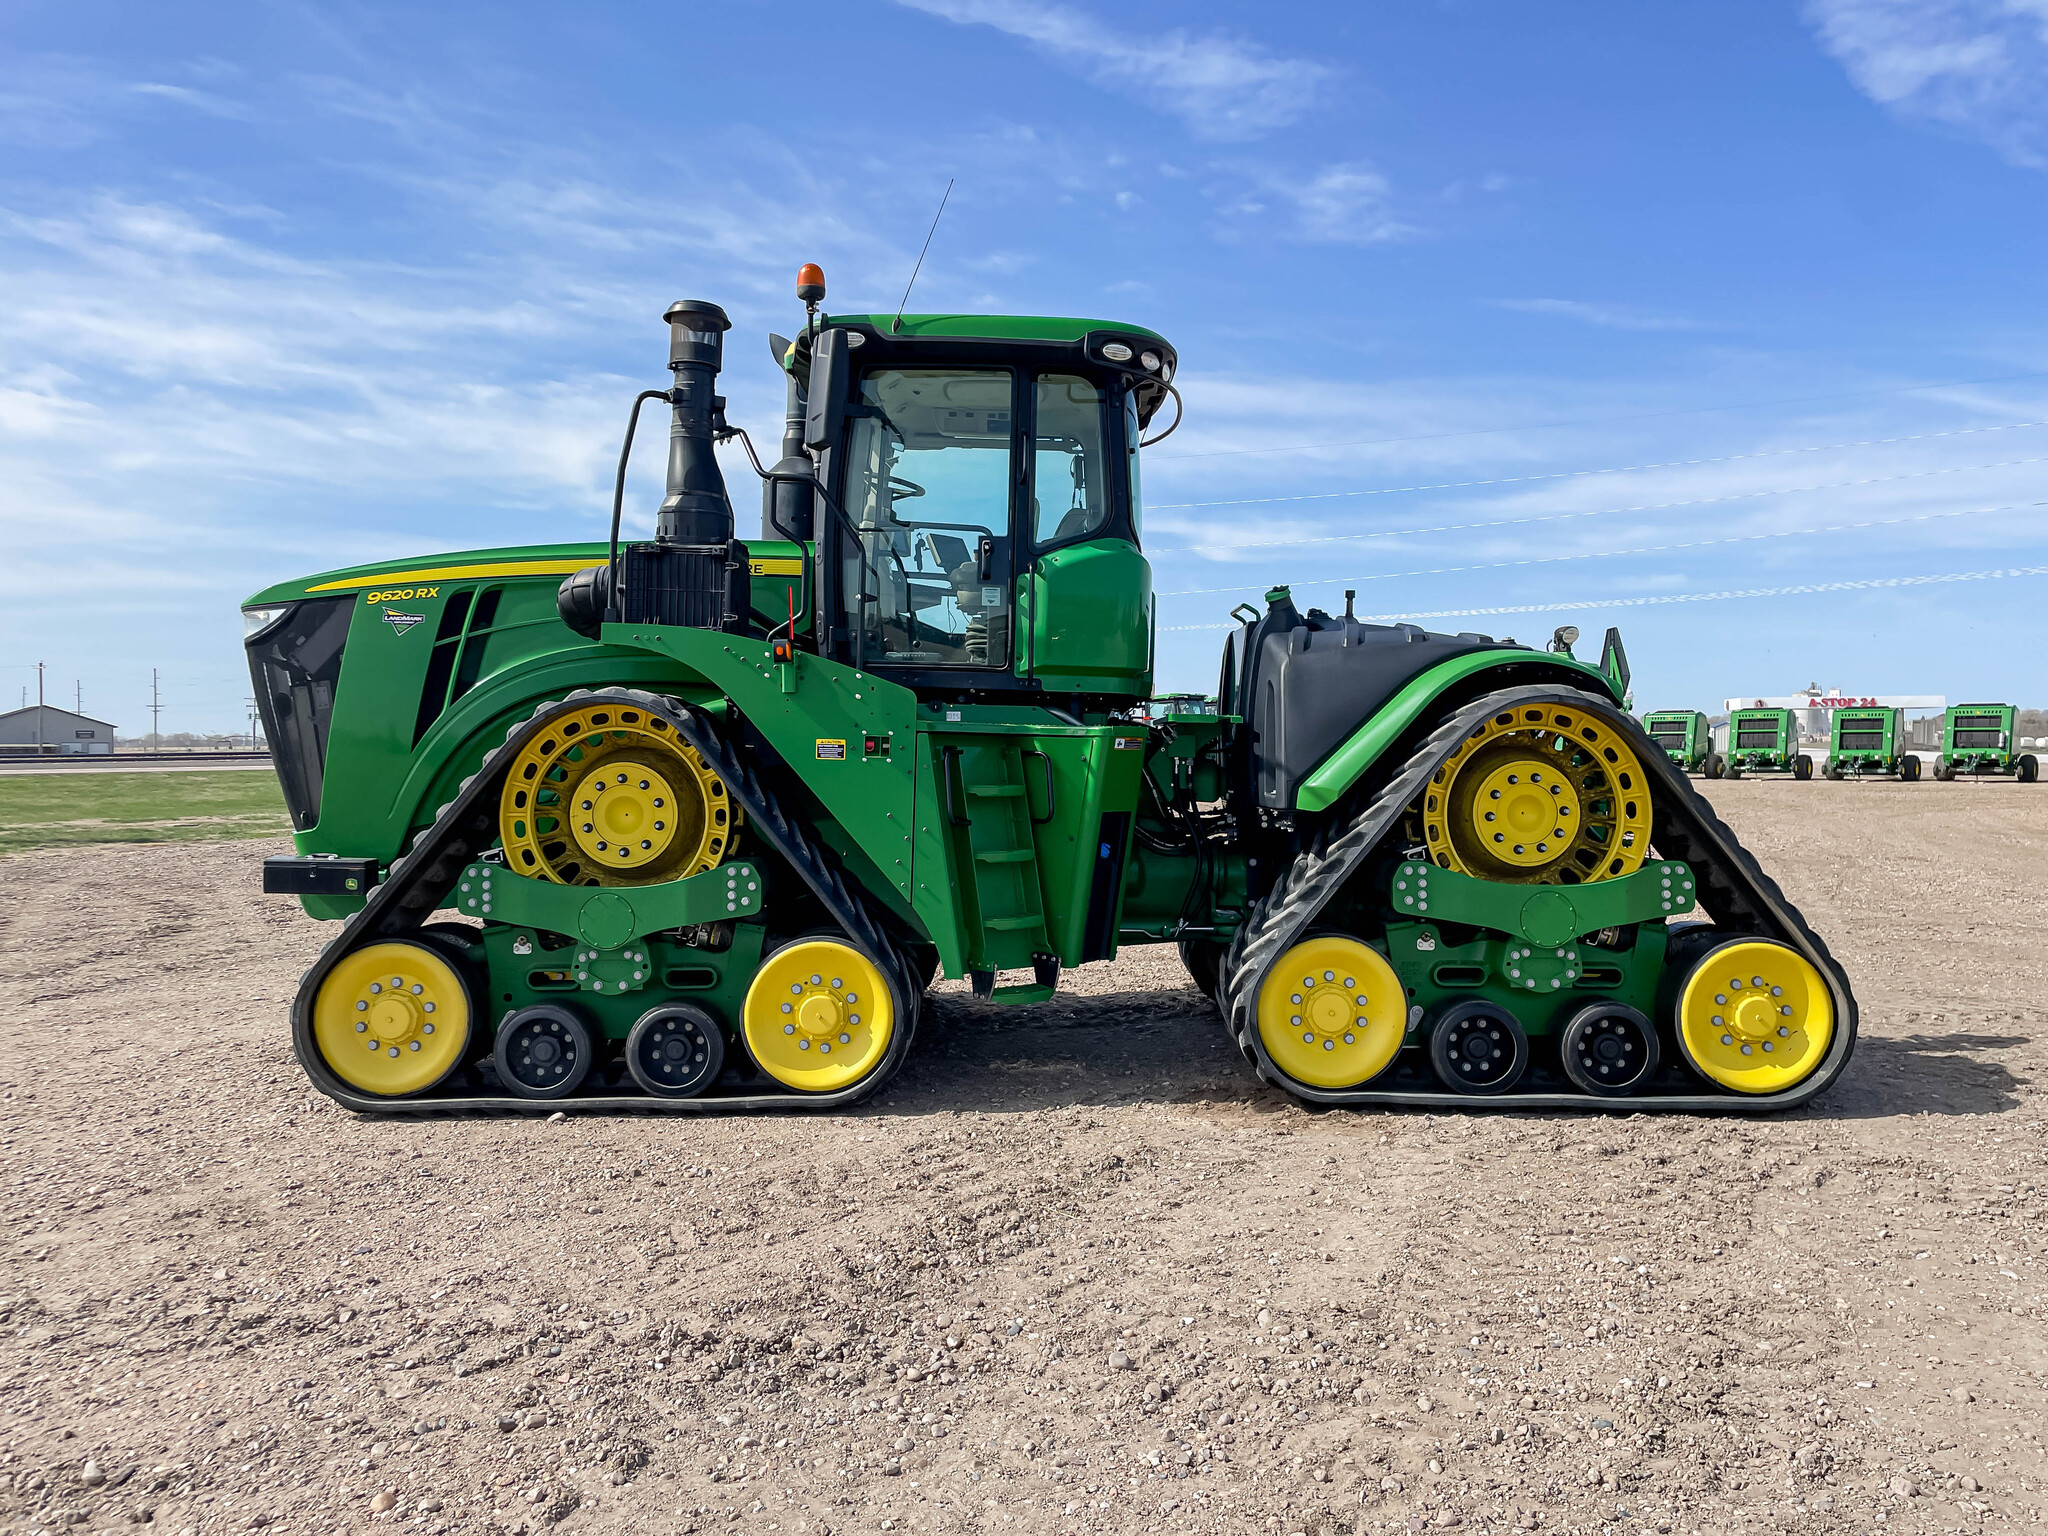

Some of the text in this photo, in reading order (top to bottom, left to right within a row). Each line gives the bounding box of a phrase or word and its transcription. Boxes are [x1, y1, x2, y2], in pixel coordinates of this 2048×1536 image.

[366, 586, 440, 605] 9620 RX
[1808, 697, 1877, 708] A-STOP 24
